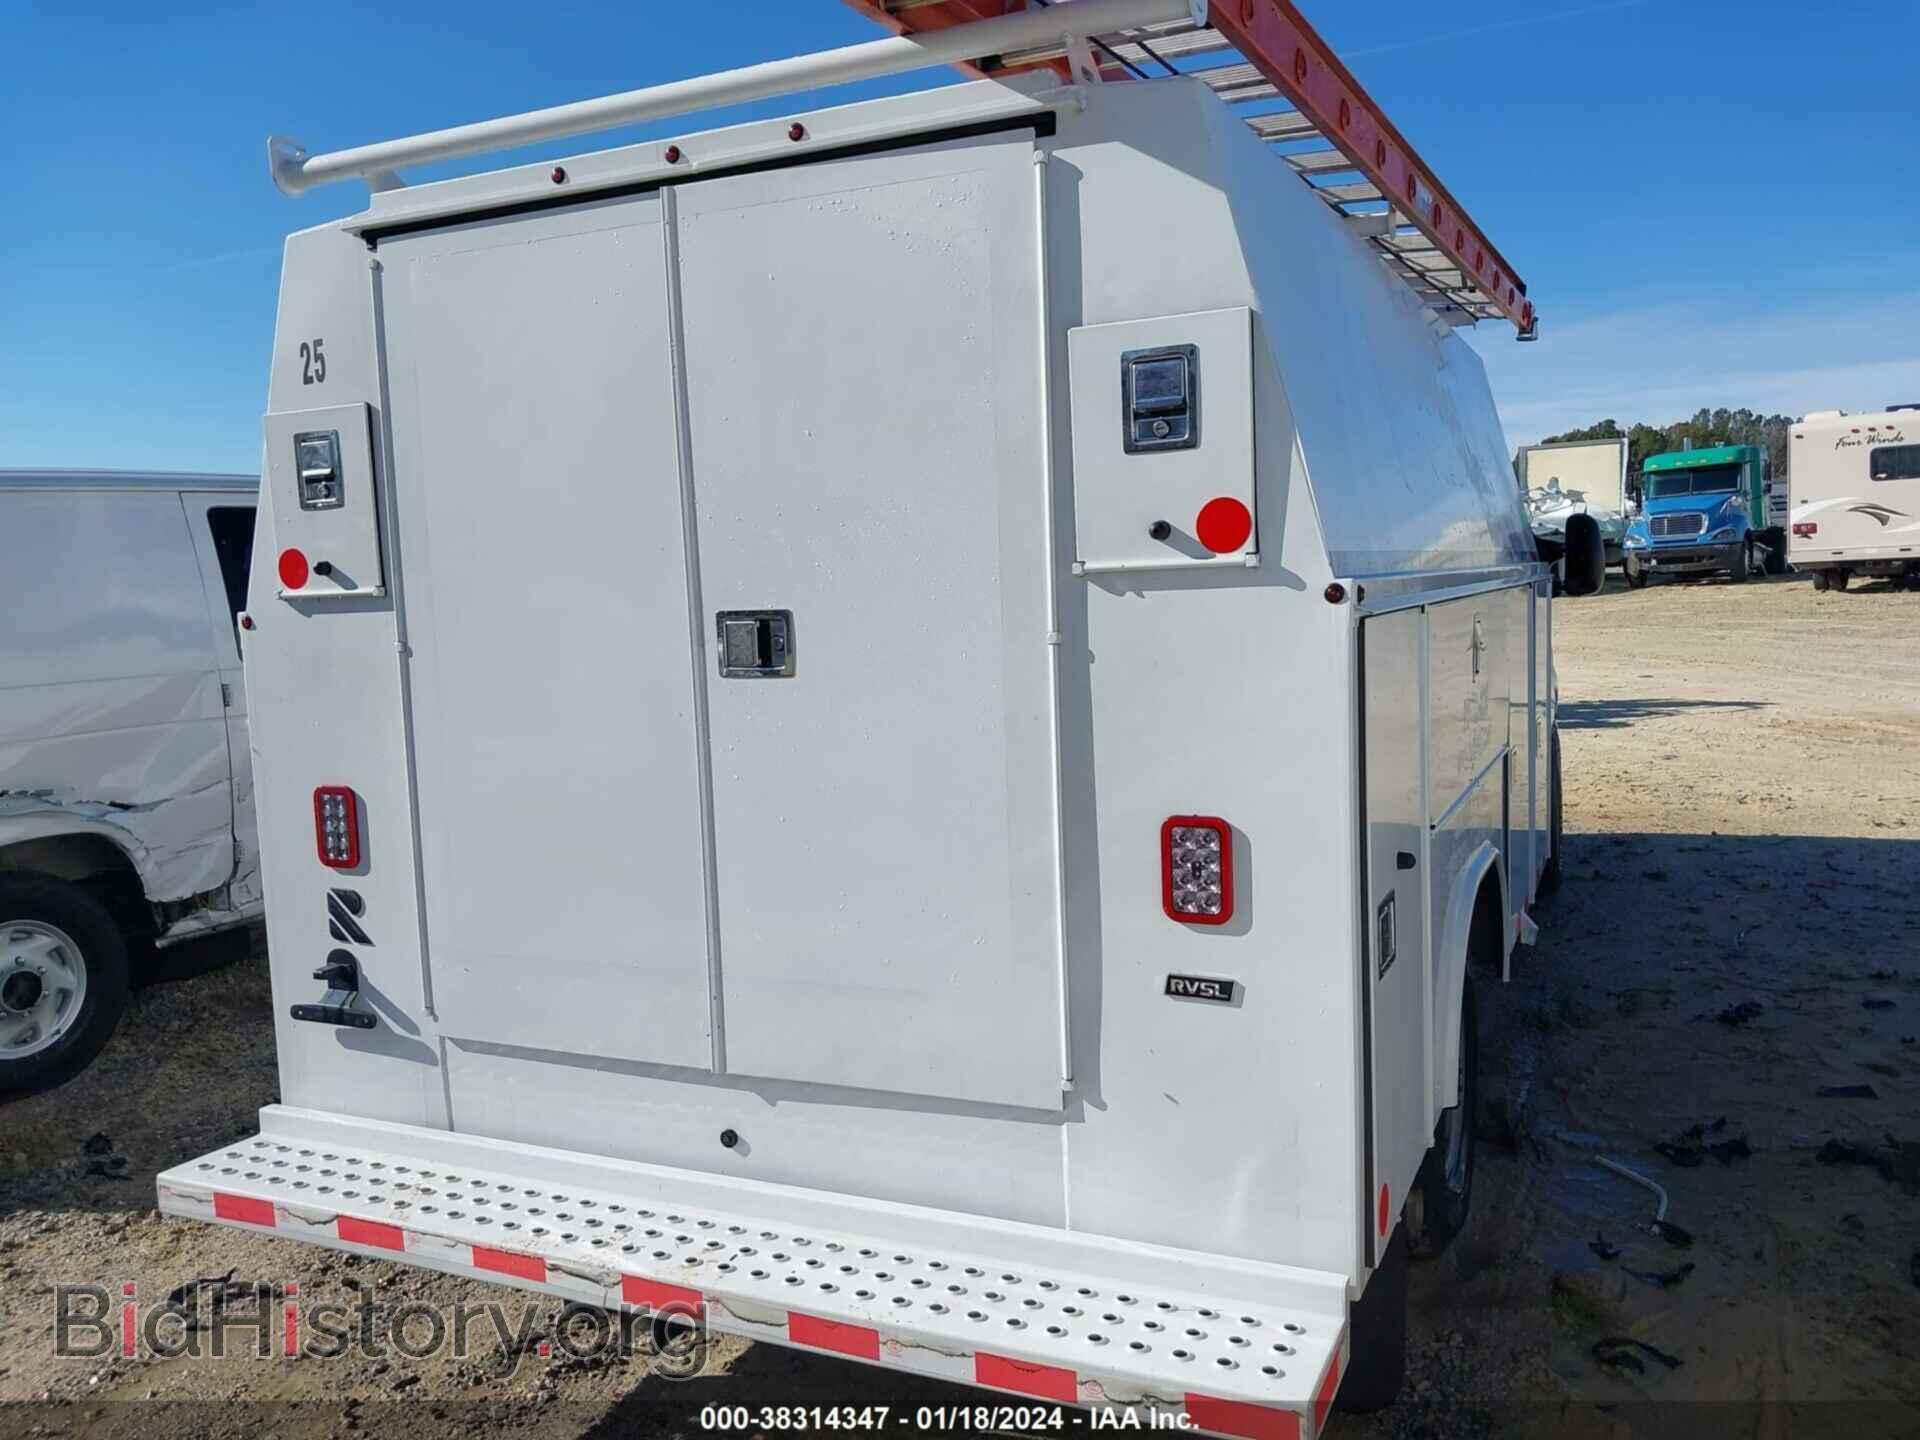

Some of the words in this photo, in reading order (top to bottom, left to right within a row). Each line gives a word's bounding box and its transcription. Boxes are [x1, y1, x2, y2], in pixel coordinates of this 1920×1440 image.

[300, 338, 326, 385] 25
[1834, 435, 1861, 450] Four
[1865, 431, 1904, 444] Winds
